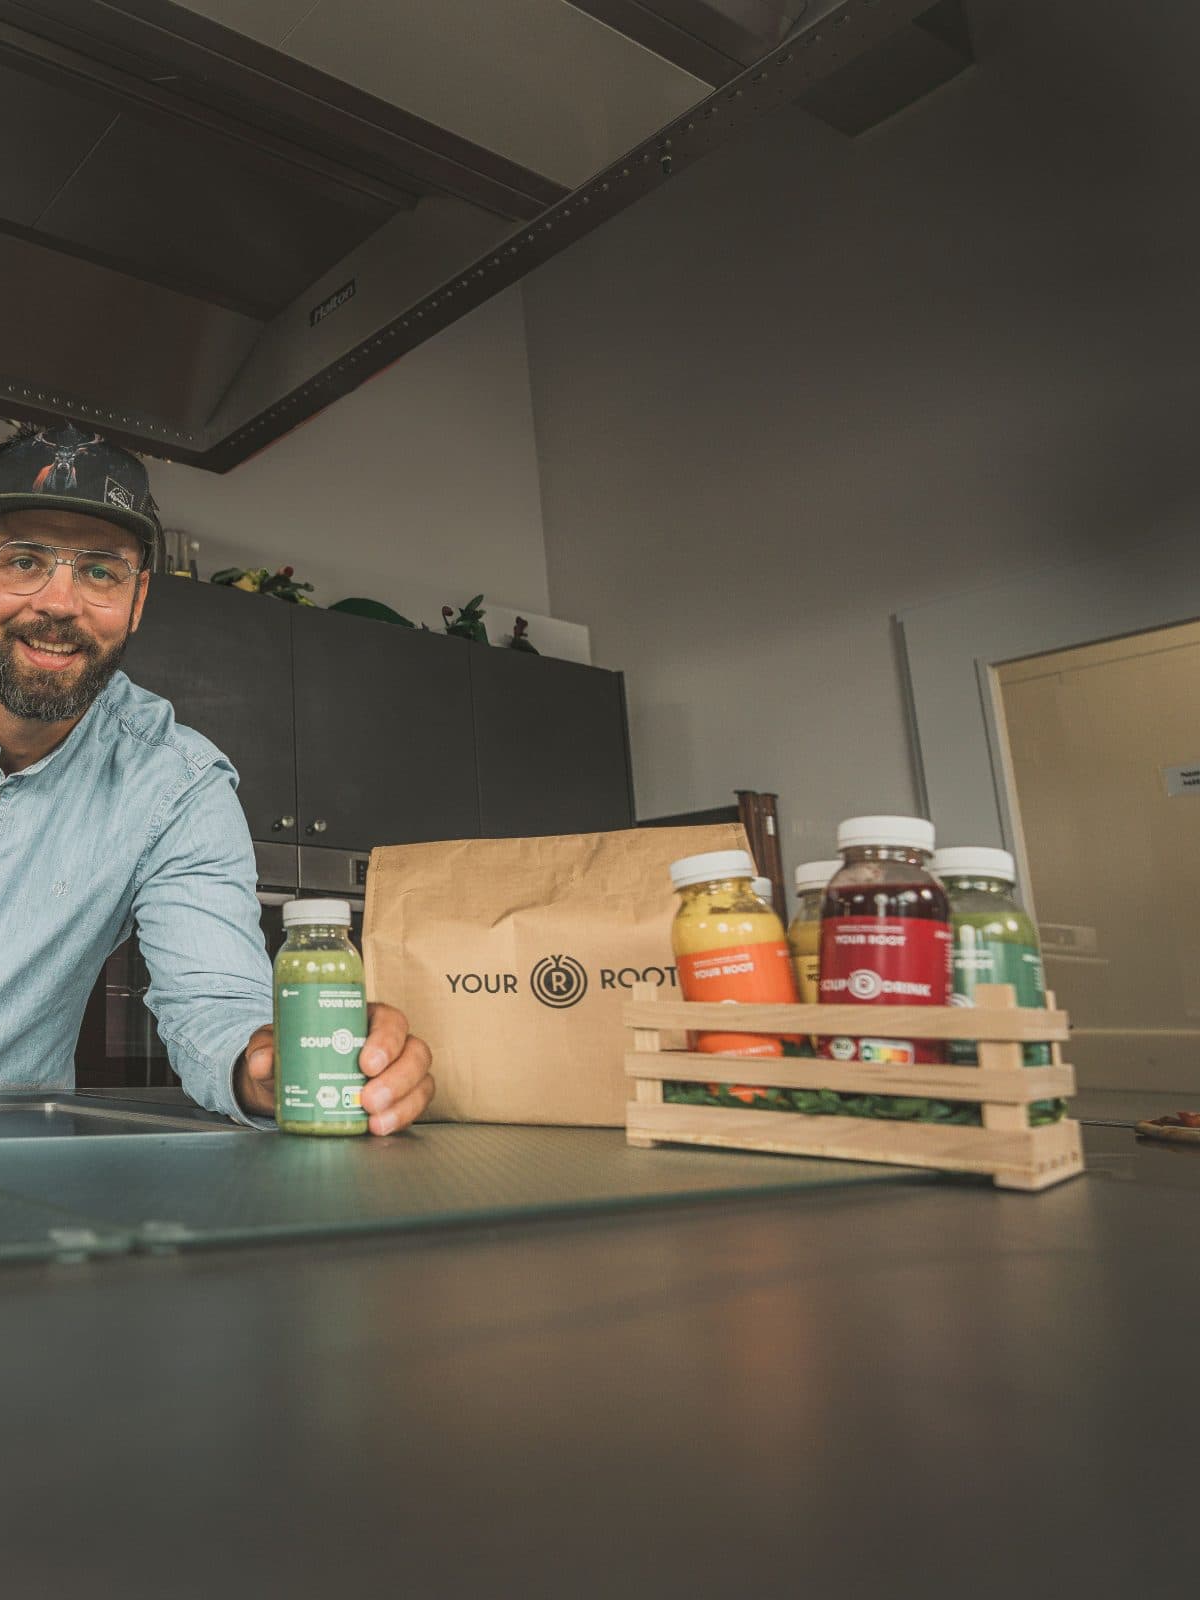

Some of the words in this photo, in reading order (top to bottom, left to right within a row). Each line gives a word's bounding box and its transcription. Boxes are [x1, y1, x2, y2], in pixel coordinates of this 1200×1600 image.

[836, 935, 866, 945] YOUR
[868, 935, 906, 946] ROOT
[446, 973, 518, 994] YOUR
[600, 966, 677, 989] ROOT
[882, 980, 931, 996] DRINK
[319, 999, 343, 1008] YOUR
[300, 1036, 331, 1048] SOUP
